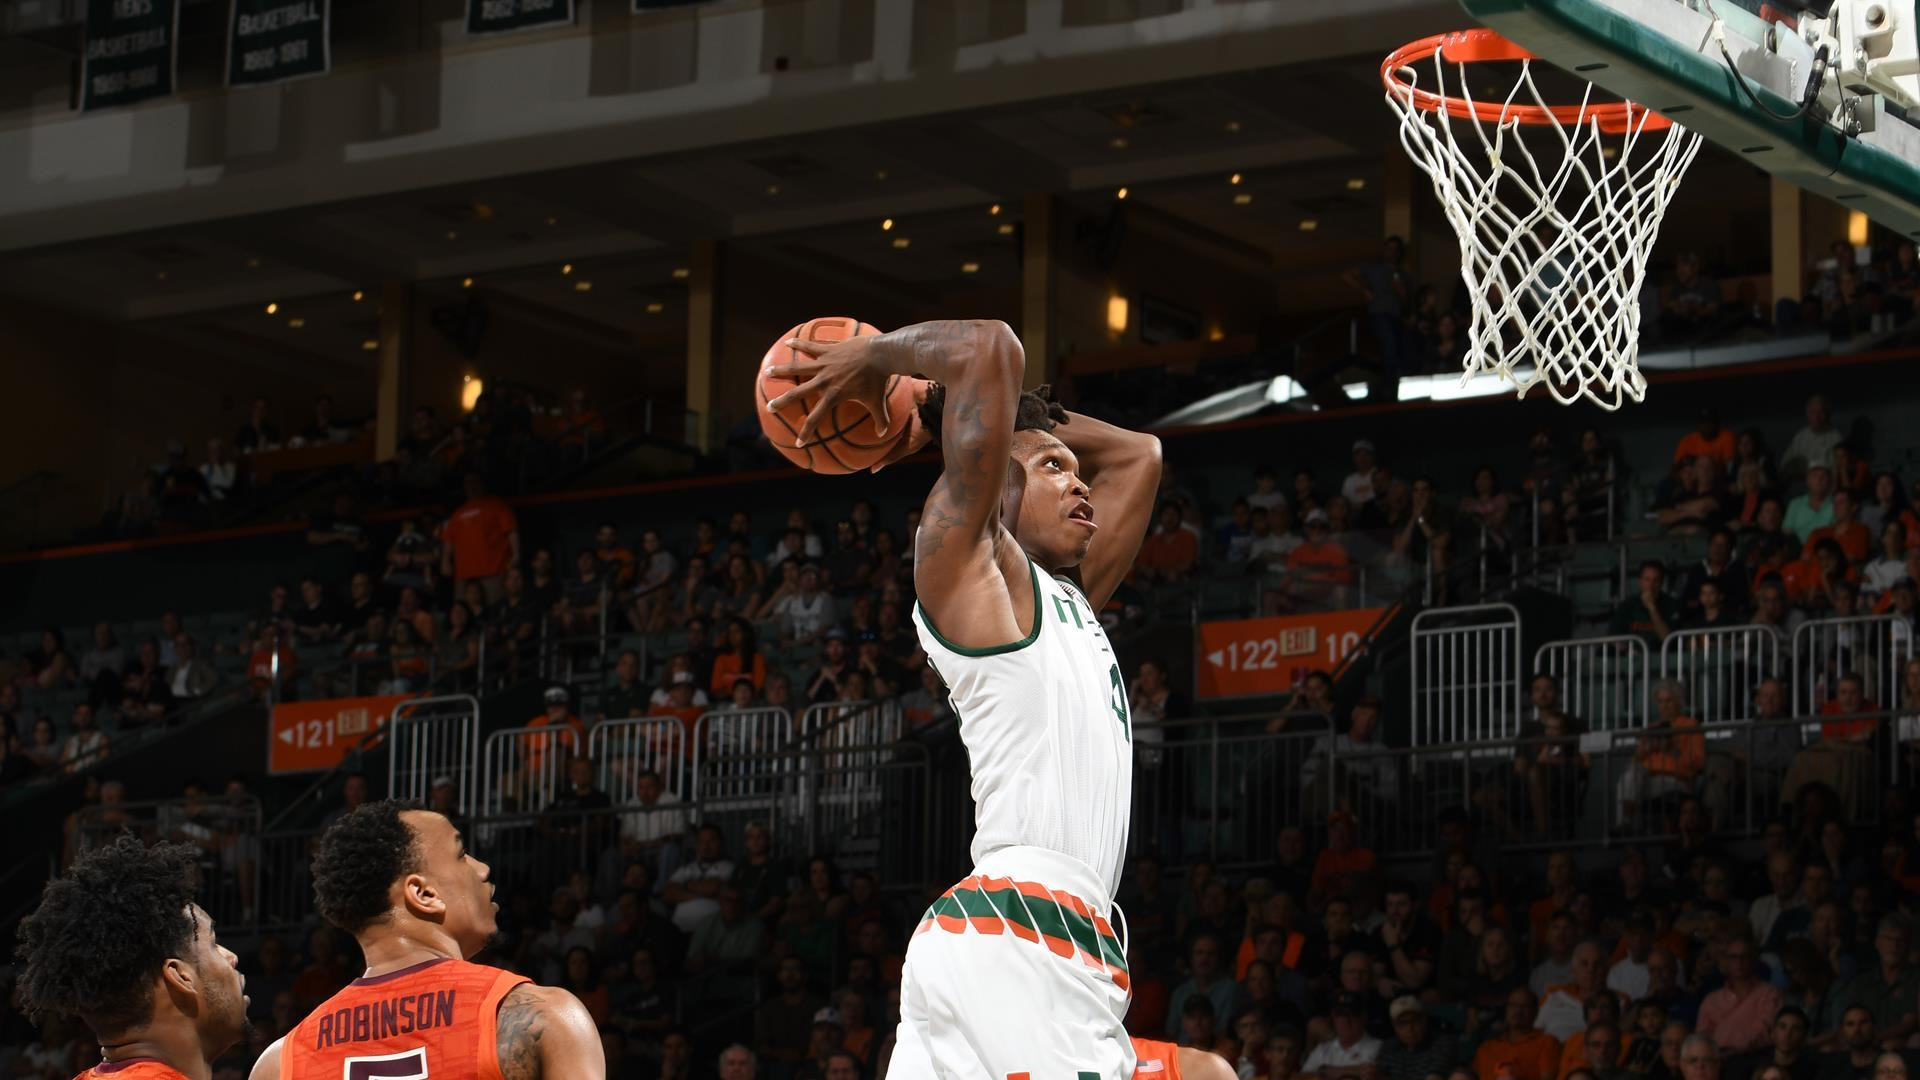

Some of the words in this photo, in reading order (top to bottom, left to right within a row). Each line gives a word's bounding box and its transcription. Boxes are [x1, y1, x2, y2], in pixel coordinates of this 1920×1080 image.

[237, 1, 321, 36] BASKETBALL
[87, 25, 168, 60] BASKETBALL
[1227, 637, 1279, 672] 122
[295, 719, 334, 750] 121
[316, 989, 456, 1050] ROBINSON
